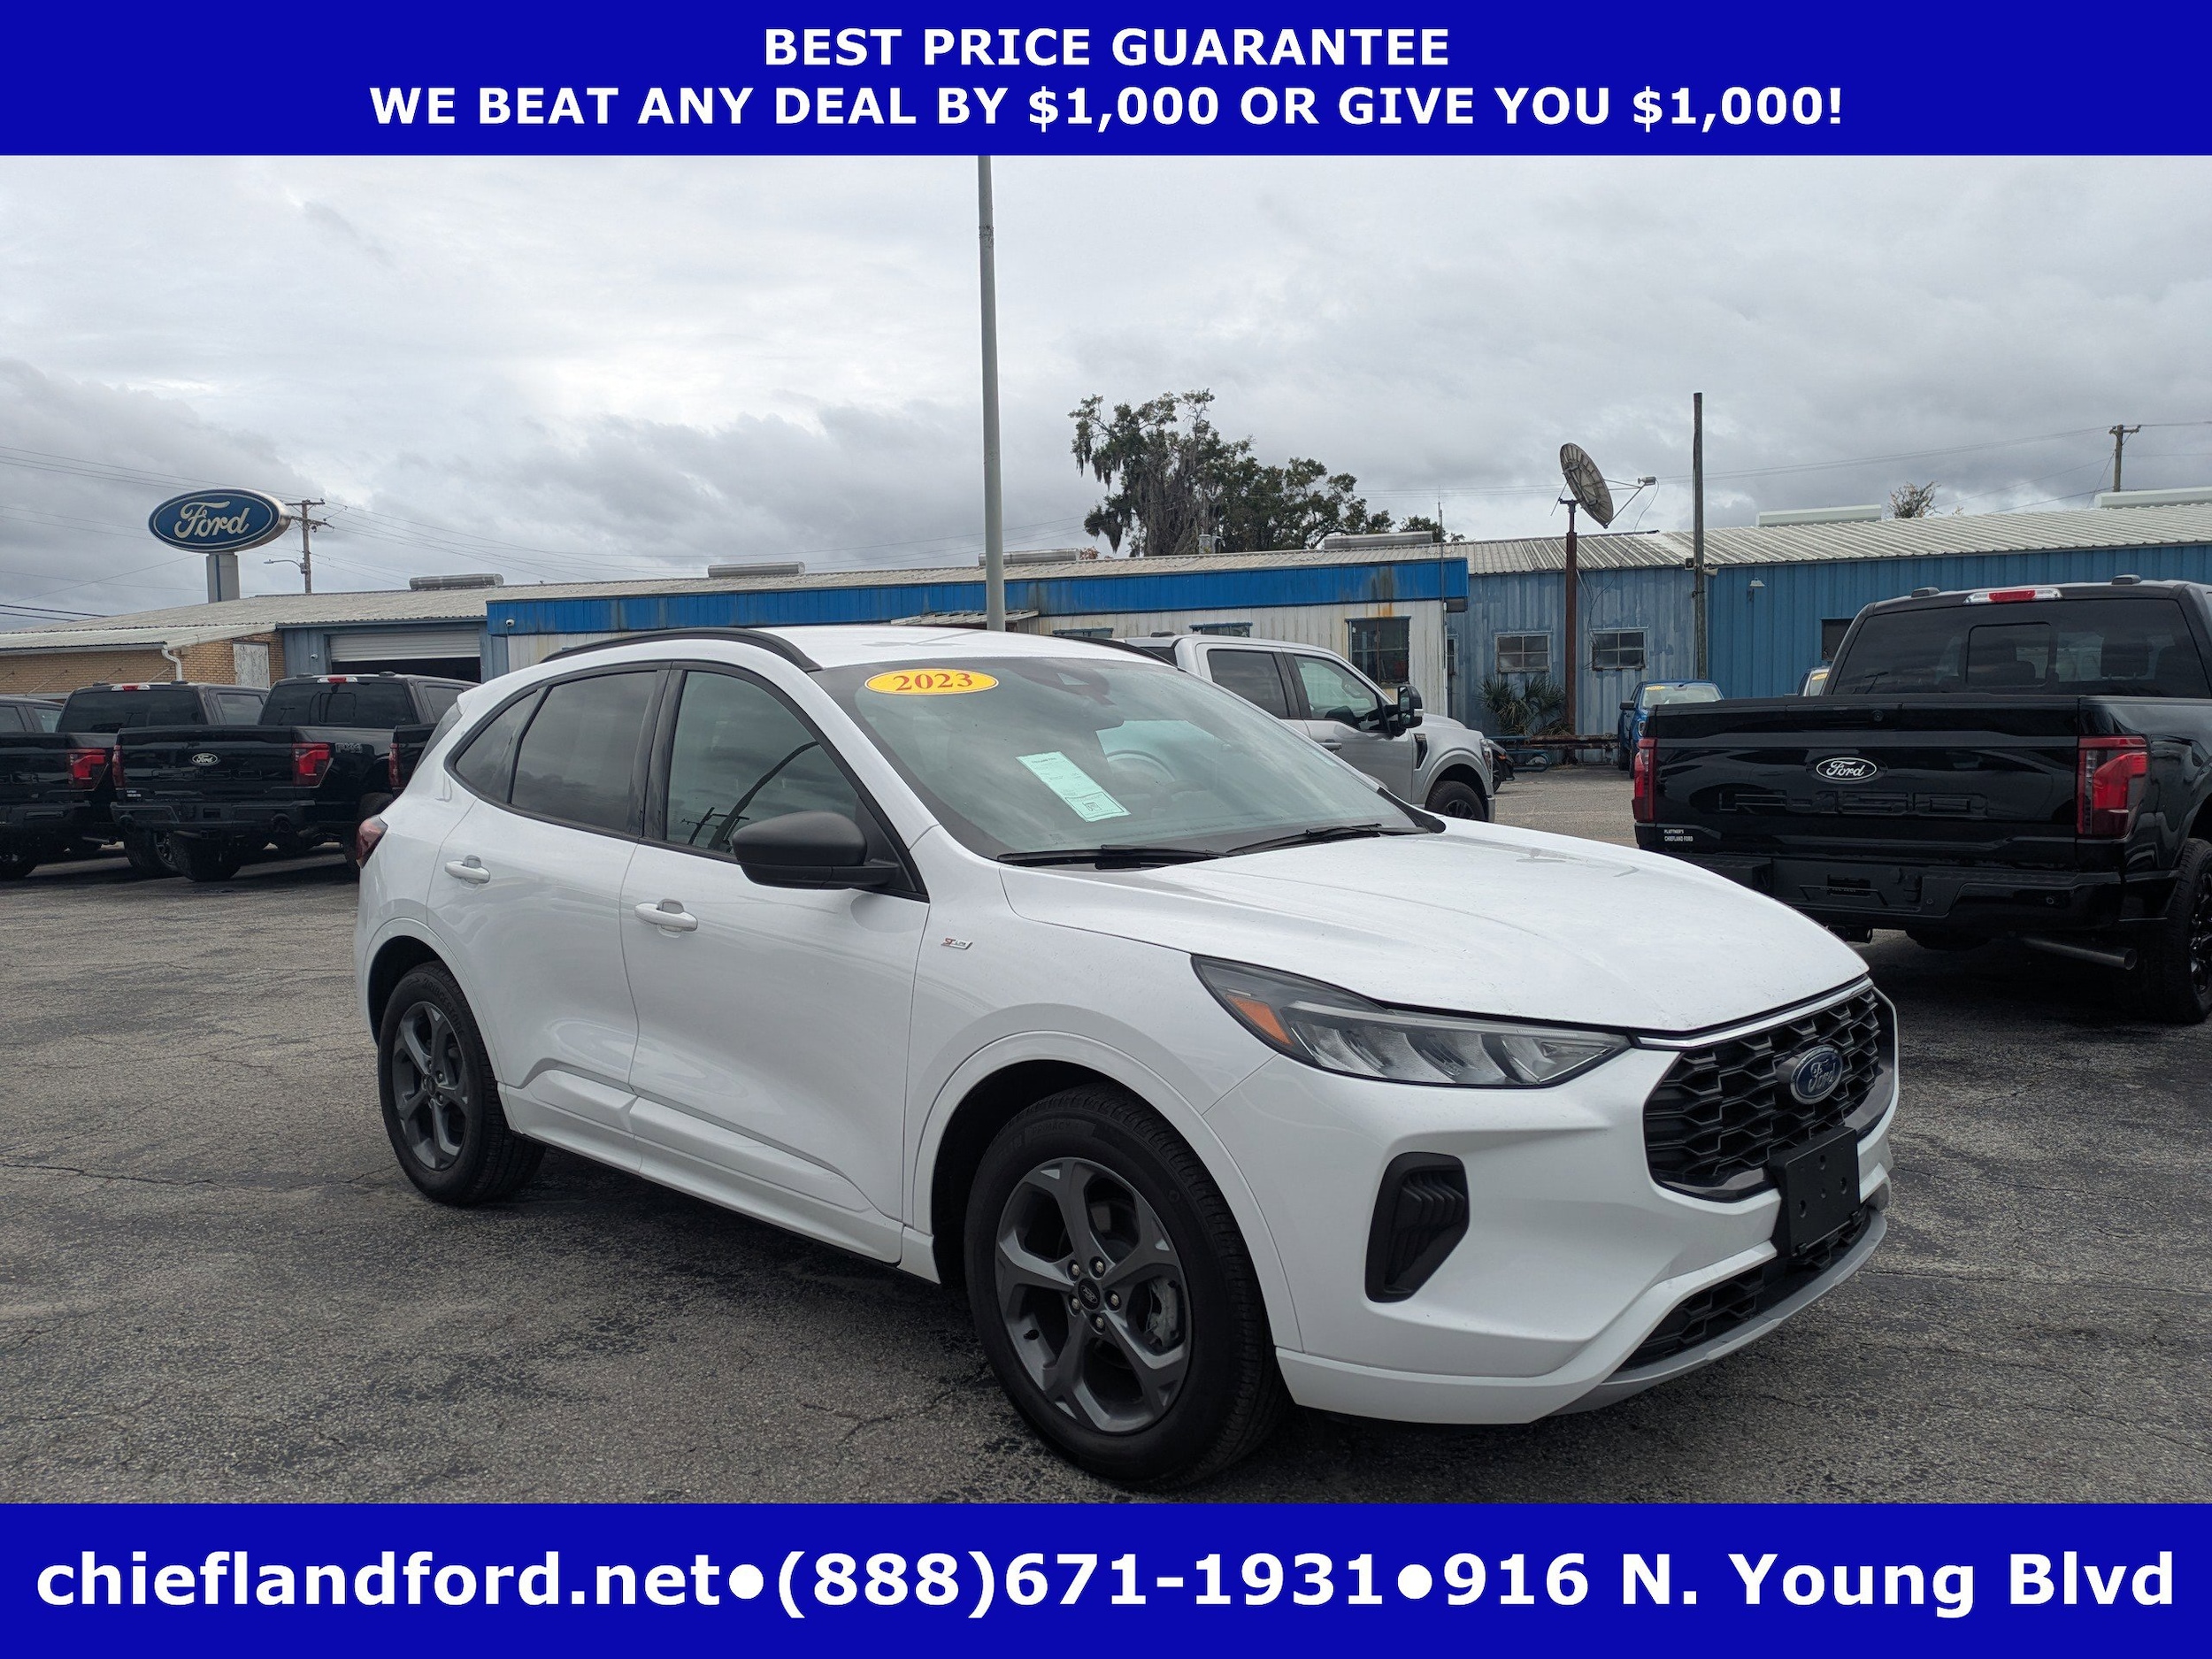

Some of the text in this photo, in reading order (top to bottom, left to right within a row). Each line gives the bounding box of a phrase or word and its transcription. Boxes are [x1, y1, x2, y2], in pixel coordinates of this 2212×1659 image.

[173, 500, 250, 538] Ford
[893, 673, 973, 691] 2023
[1825, 760, 1866, 776] Ford
[1808, 1058, 1836, 1093] Ford
